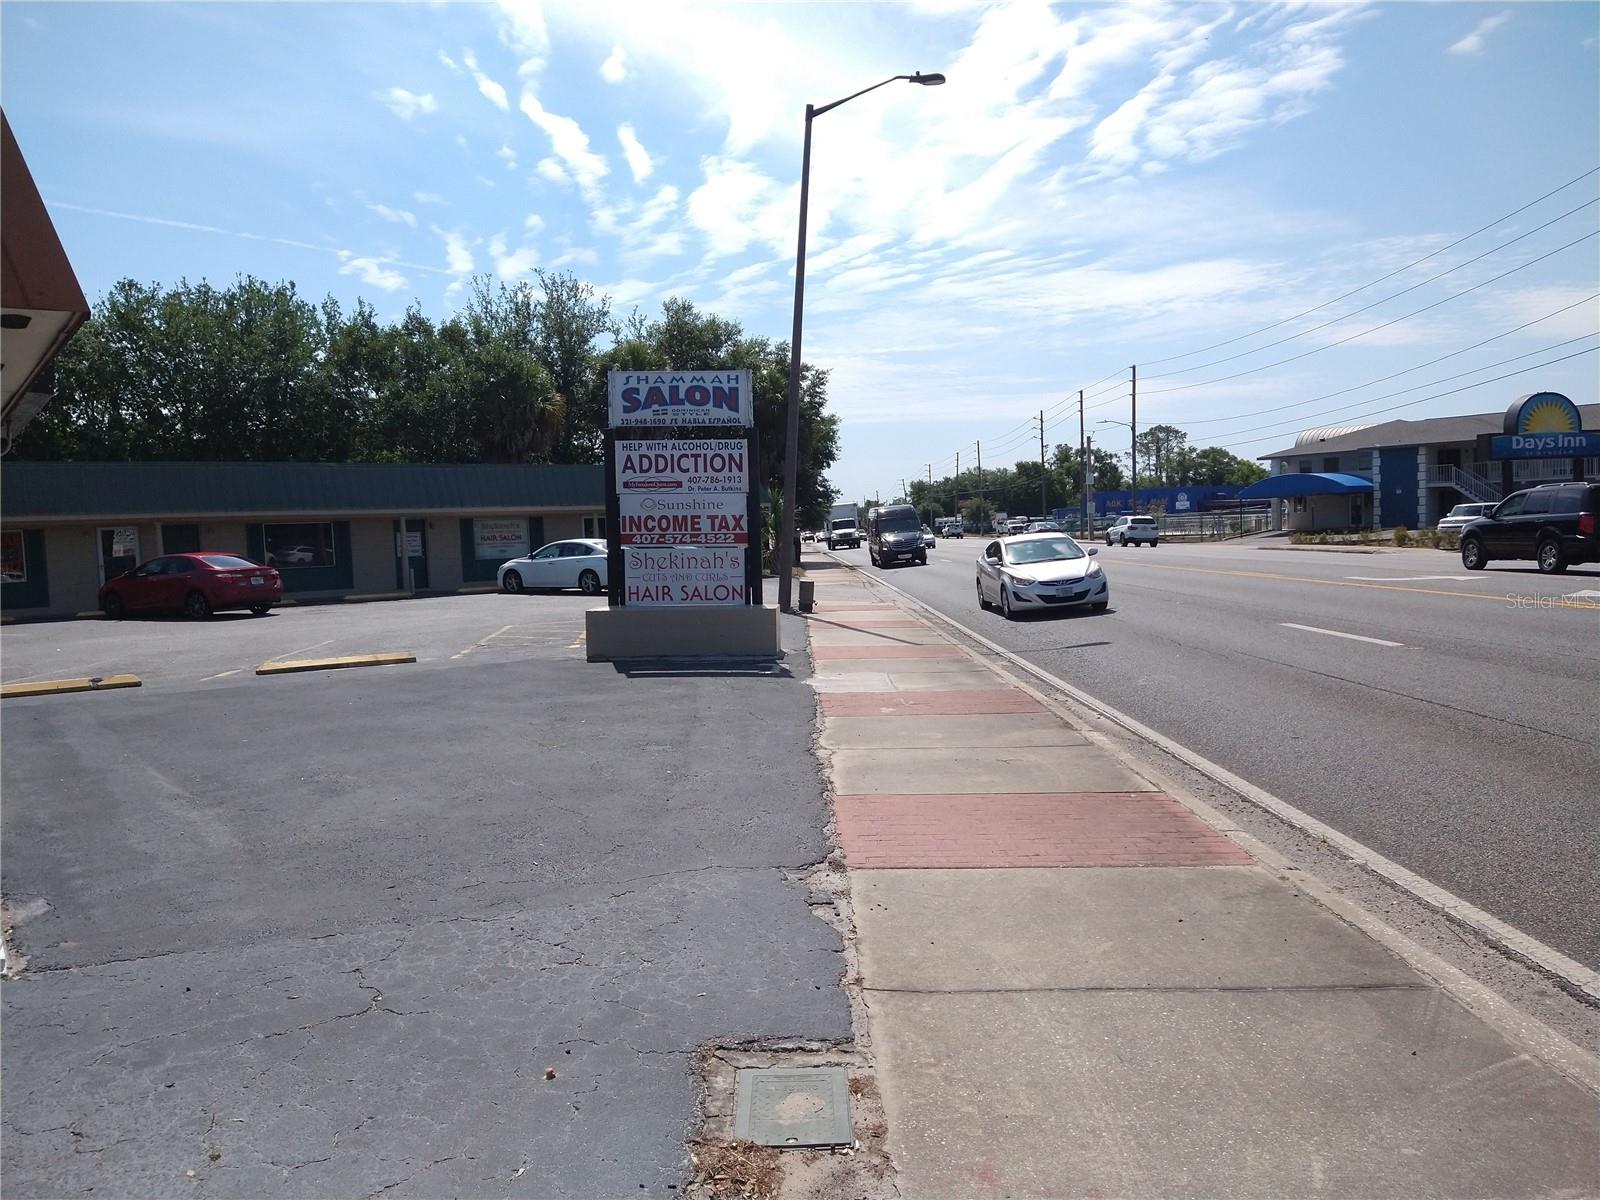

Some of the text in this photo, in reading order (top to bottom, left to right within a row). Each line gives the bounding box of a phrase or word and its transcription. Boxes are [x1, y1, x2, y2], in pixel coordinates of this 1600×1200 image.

[623, 375, 739, 385] SHAMMAH
[621, 385, 739, 414] SALON
[708, 416, 741, 425] ESPAÑOL
[622, 442, 643, 451] HELP
[646, 442, 668, 451] WITH
[1512, 434, 1586, 450] Days Inn
[622, 453, 743, 474] ADDICTION
[687, 476, 742, 484] 407-786-1913
[657, 499, 724, 510] Sunshine
[621, 514, 745, 532] INCOME TAX
[632, 534, 735, 544] 407-574-4522
[629, 551, 740, 570] Shekinah's
[628, 584, 744, 601] HAIR SALON
